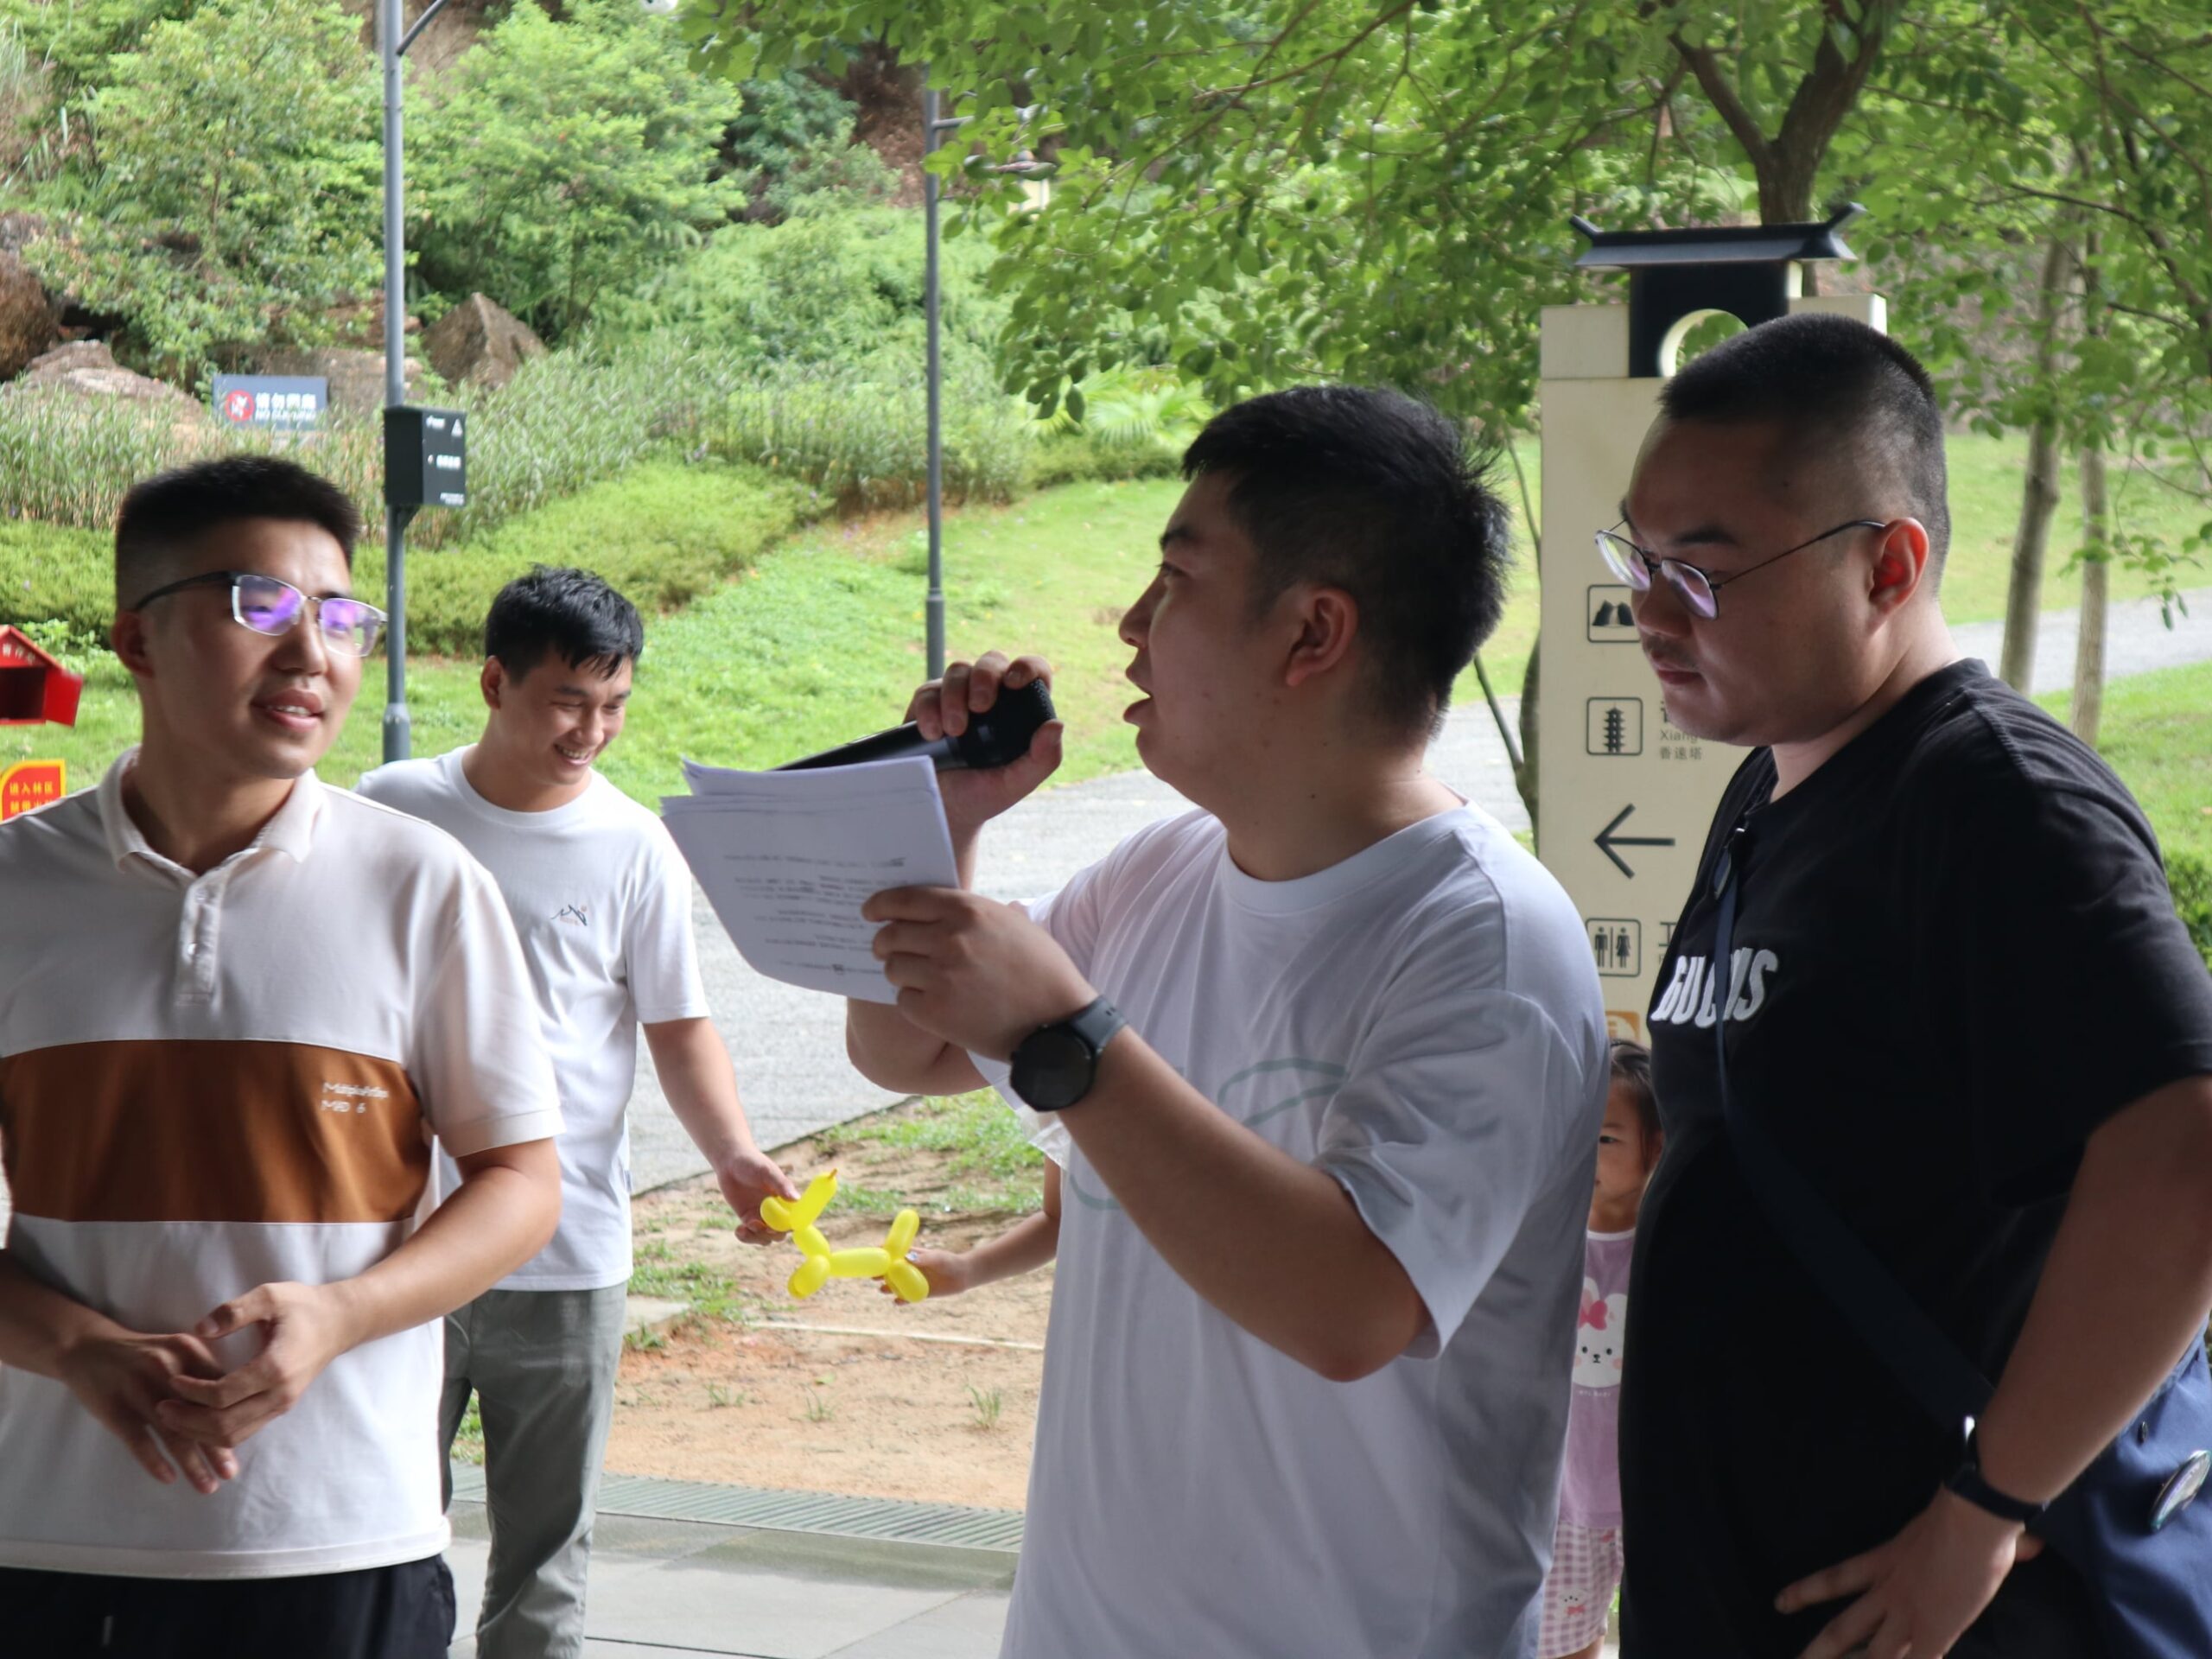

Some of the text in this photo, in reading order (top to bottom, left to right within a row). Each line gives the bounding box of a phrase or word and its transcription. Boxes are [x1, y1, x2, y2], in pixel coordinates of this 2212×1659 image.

[10, 781, 53, 796] 进入林区
[10, 799, 52, 814] 禁带火
